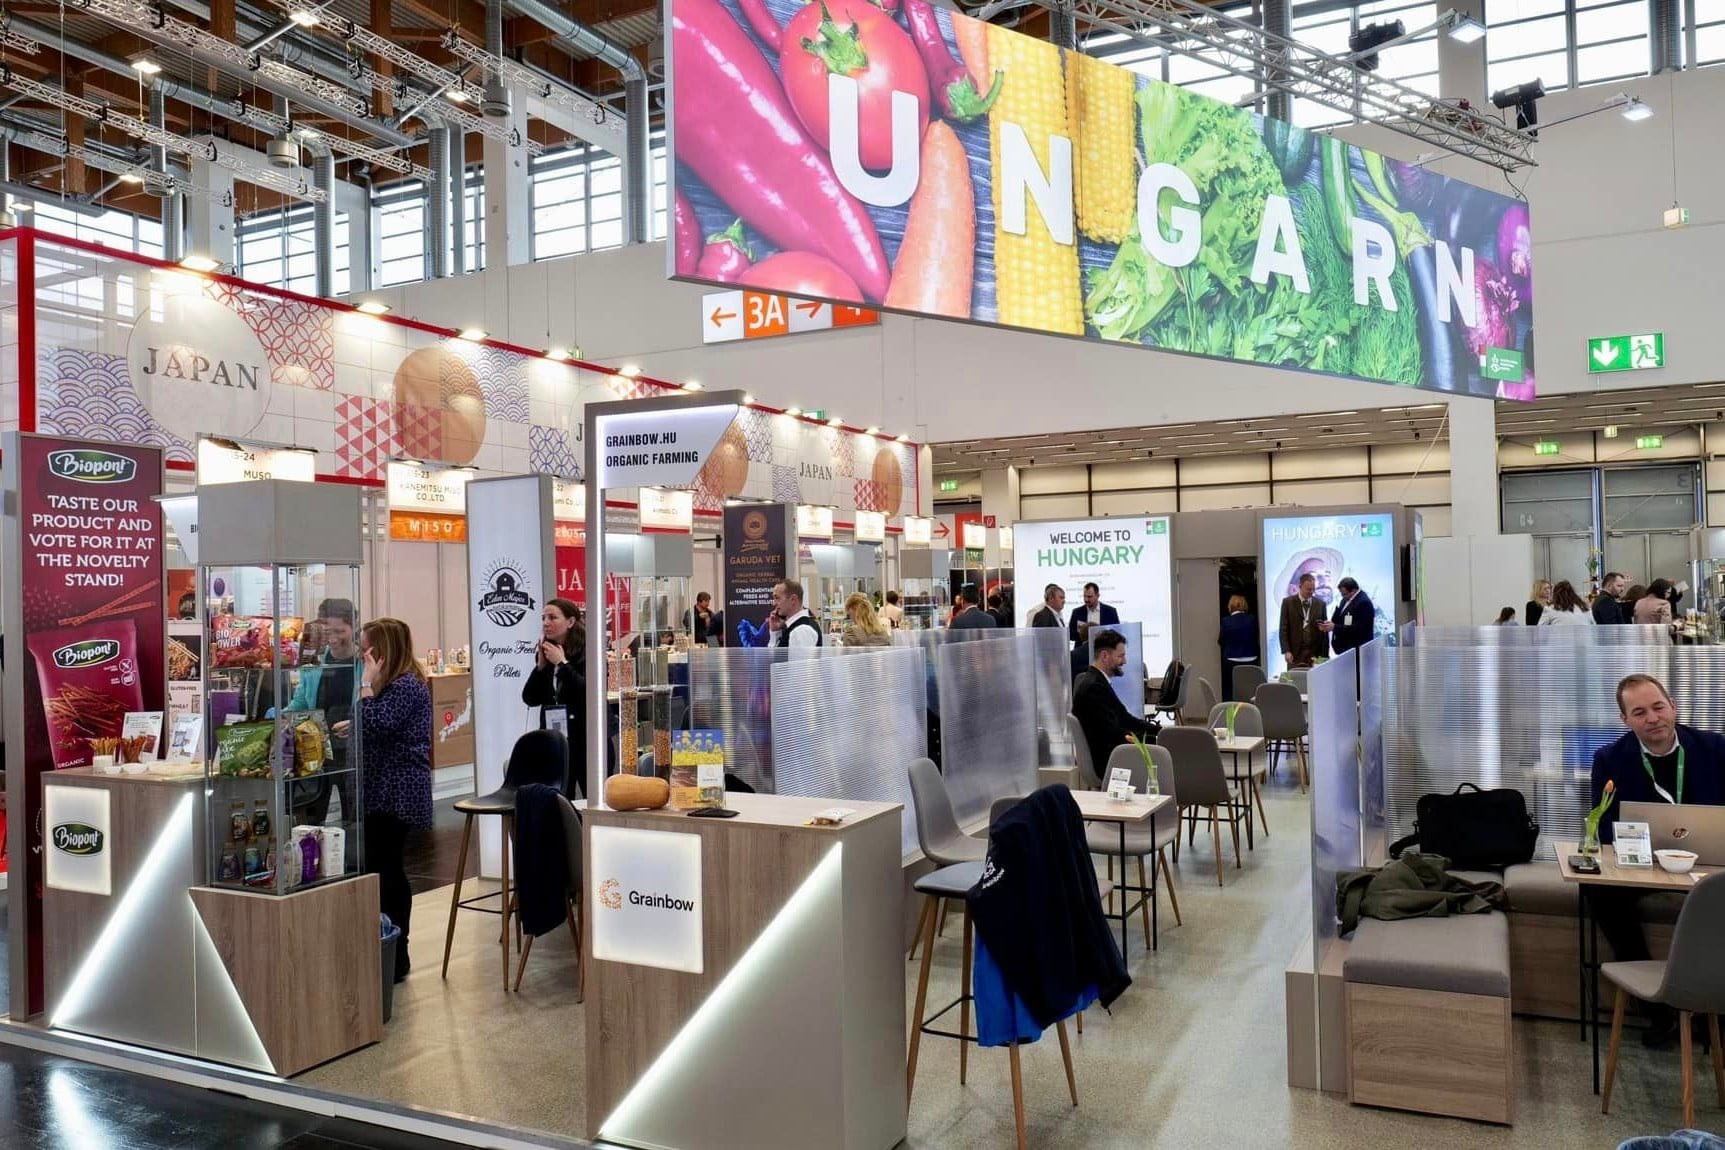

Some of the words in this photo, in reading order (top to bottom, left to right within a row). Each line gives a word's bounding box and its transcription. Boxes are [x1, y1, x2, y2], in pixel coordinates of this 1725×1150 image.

[828, 72, 1476, 328] UNGARN
[749, 294, 785, 330] 3A
[142, 346, 260, 391] JAPAN
[605, 432, 677, 447] GRAINBOW.HU
[55, 453, 130, 475] Biopont
[605, 454, 649, 467] ORGANIC
[652, 451, 699, 465] FARMING
[799, 461, 833, 481] JAPAN
[47, 495, 100, 510] TASTE
[103, 499, 138, 513] OUR
[32, 514, 115, 531] PRODUCT
[118, 518, 152, 532] AND
[409, 519, 453, 533] MISO
[29, 533, 77, 548] VOTE
[80, 535, 113, 549] FOR
[116, 536, 132, 549] IT
[135, 537, 156, 550] AT
[1050, 530, 1112, 545] WELCOME
[1114, 529, 1131, 542] TO
[1271, 523, 1359, 543] HUNGARY
[36, 553, 73, 567] THE
[75, 555, 150, 568] NOVELTY
[730, 556, 764, 565] GARUDA
[766, 554, 780, 564] VET
[1037, 545, 1145, 567] HUNGARY
[64, 573, 124, 587] STAND!
[217, 636, 241, 649] OWER
[479, 641, 513, 660] Organic
[514, 640, 537, 655] Feed
[58, 642, 112, 666] Biopont
[494, 664, 521, 678] Pellets
[55, 826, 98, 849] Biopont
[628, 890, 694, 912] Grainbow
